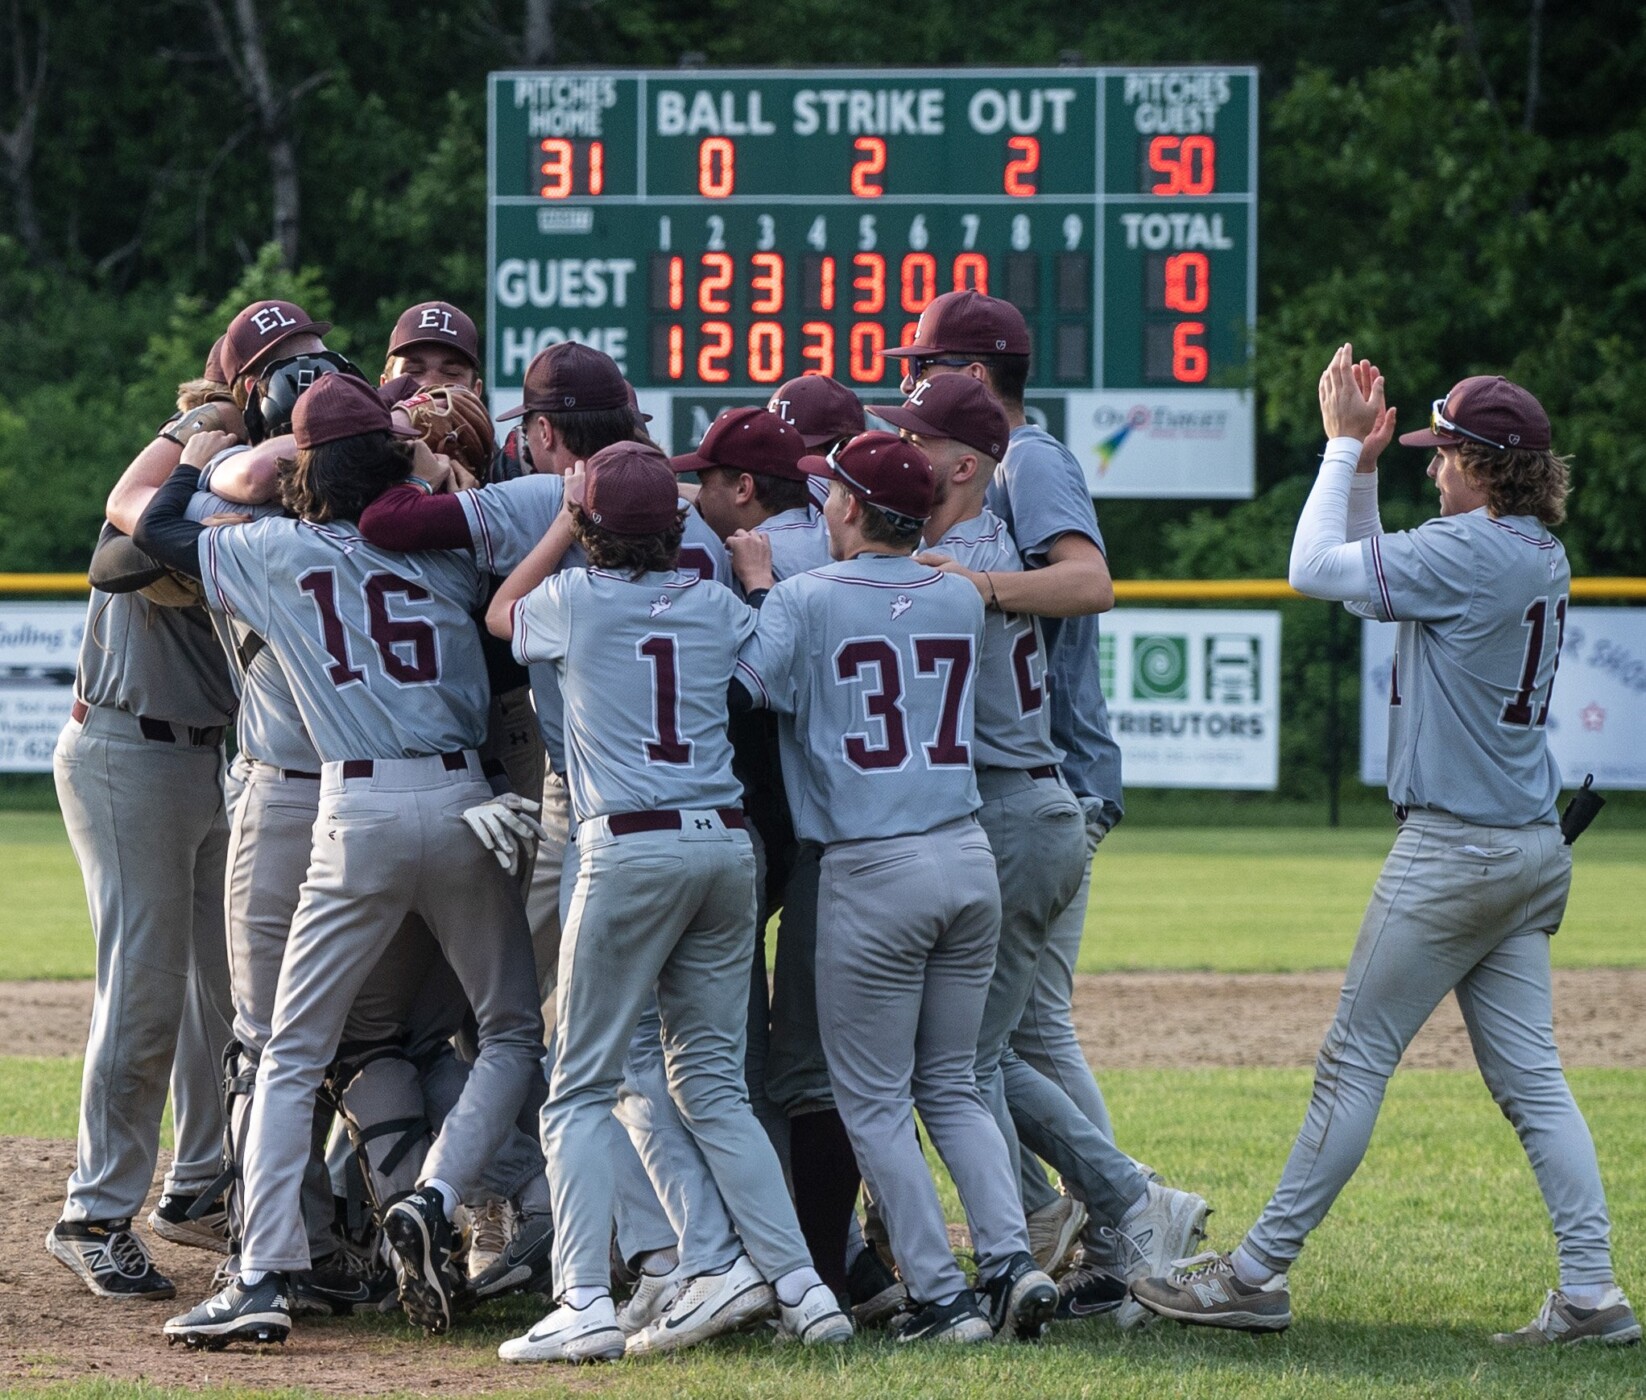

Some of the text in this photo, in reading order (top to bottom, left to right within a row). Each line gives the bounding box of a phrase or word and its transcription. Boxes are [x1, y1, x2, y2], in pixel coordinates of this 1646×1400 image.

[515, 76, 616, 108] PITCHES
[657, 87, 1076, 136] BALL STRIKE OUT
[1124, 72, 1230, 104] PITCHES
[529, 107, 602, 136] HOME
[1135, 103, 1220, 134] GUEST
[540, 138, 604, 198] 31
[699, 135, 1040, 198] 0 2 2
[1148, 135, 1215, 196] 50
[659, 214, 1082, 251] 1 2 3 4 5 6 7 8 9
[1120, 213, 1233, 250] TOTAL
[496, 259, 635, 308] GUEST
[668, 256, 684, 310] 1
[699, 252, 733, 314] 2
[751, 252, 785, 314] 3
[820, 256, 835, 310] 1
[853, 252, 886, 314] 3
[901, 252, 936, 314] 0
[250, 306, 296, 335] EL
[418, 308, 457, 336] EL
[668, 324, 684, 379] 1
[698, 321, 733, 382] 2
[748, 321, 784, 382] 0
[802, 321, 835, 377] 3
[850, 321, 885, 382] 0
[1172, 321, 1209, 382] 6
[296, 566, 441, 692] 16
[1497, 593, 1569, 730] 11
[635, 631, 695, 768] 1
[831, 633, 975, 776] 37
